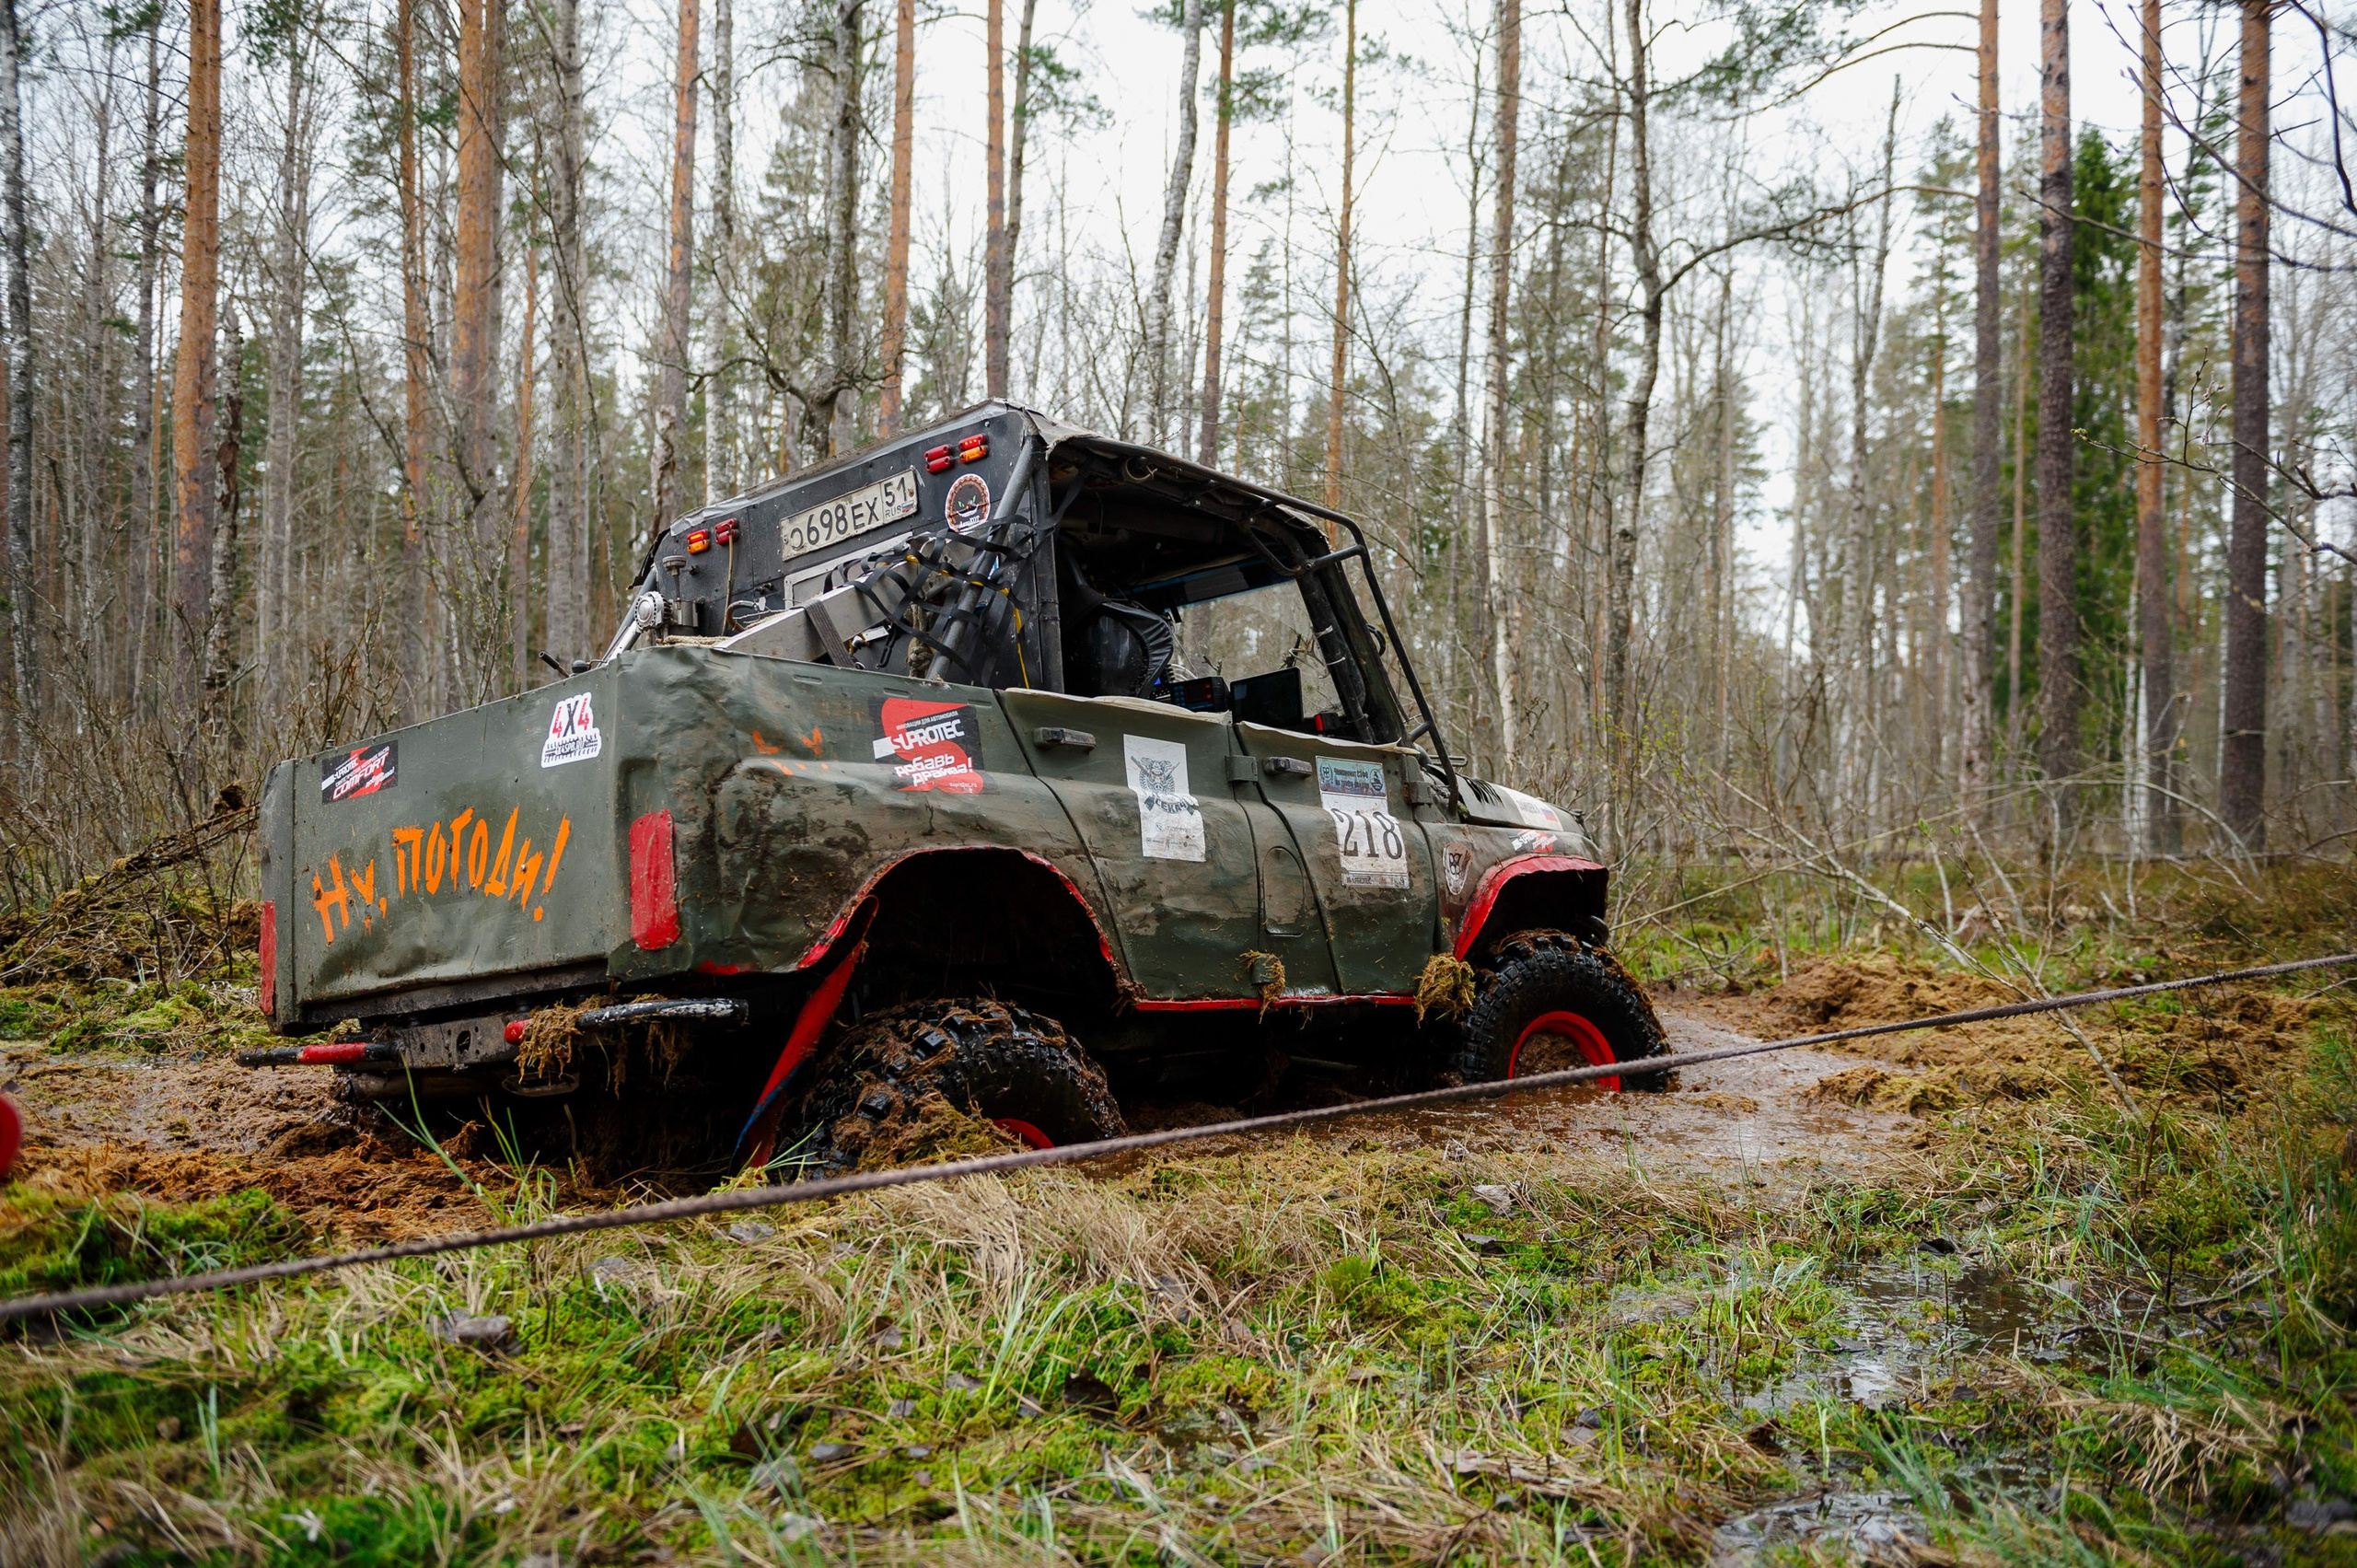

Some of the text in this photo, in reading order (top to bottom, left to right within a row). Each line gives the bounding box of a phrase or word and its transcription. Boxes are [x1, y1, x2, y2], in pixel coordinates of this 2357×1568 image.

[884, 477, 907, 506] 51
[885, 505, 902, 517] RUS
[332, 751, 389, 799] COMFORT
[894, 753, 956, 778] добавь
[911, 756, 973, 787] драйва!
[1155, 798, 1188, 814] СЕКАЧ
[1330, 807, 1403, 860] 218
[390, 805, 571, 922] ПОГОДИ!
